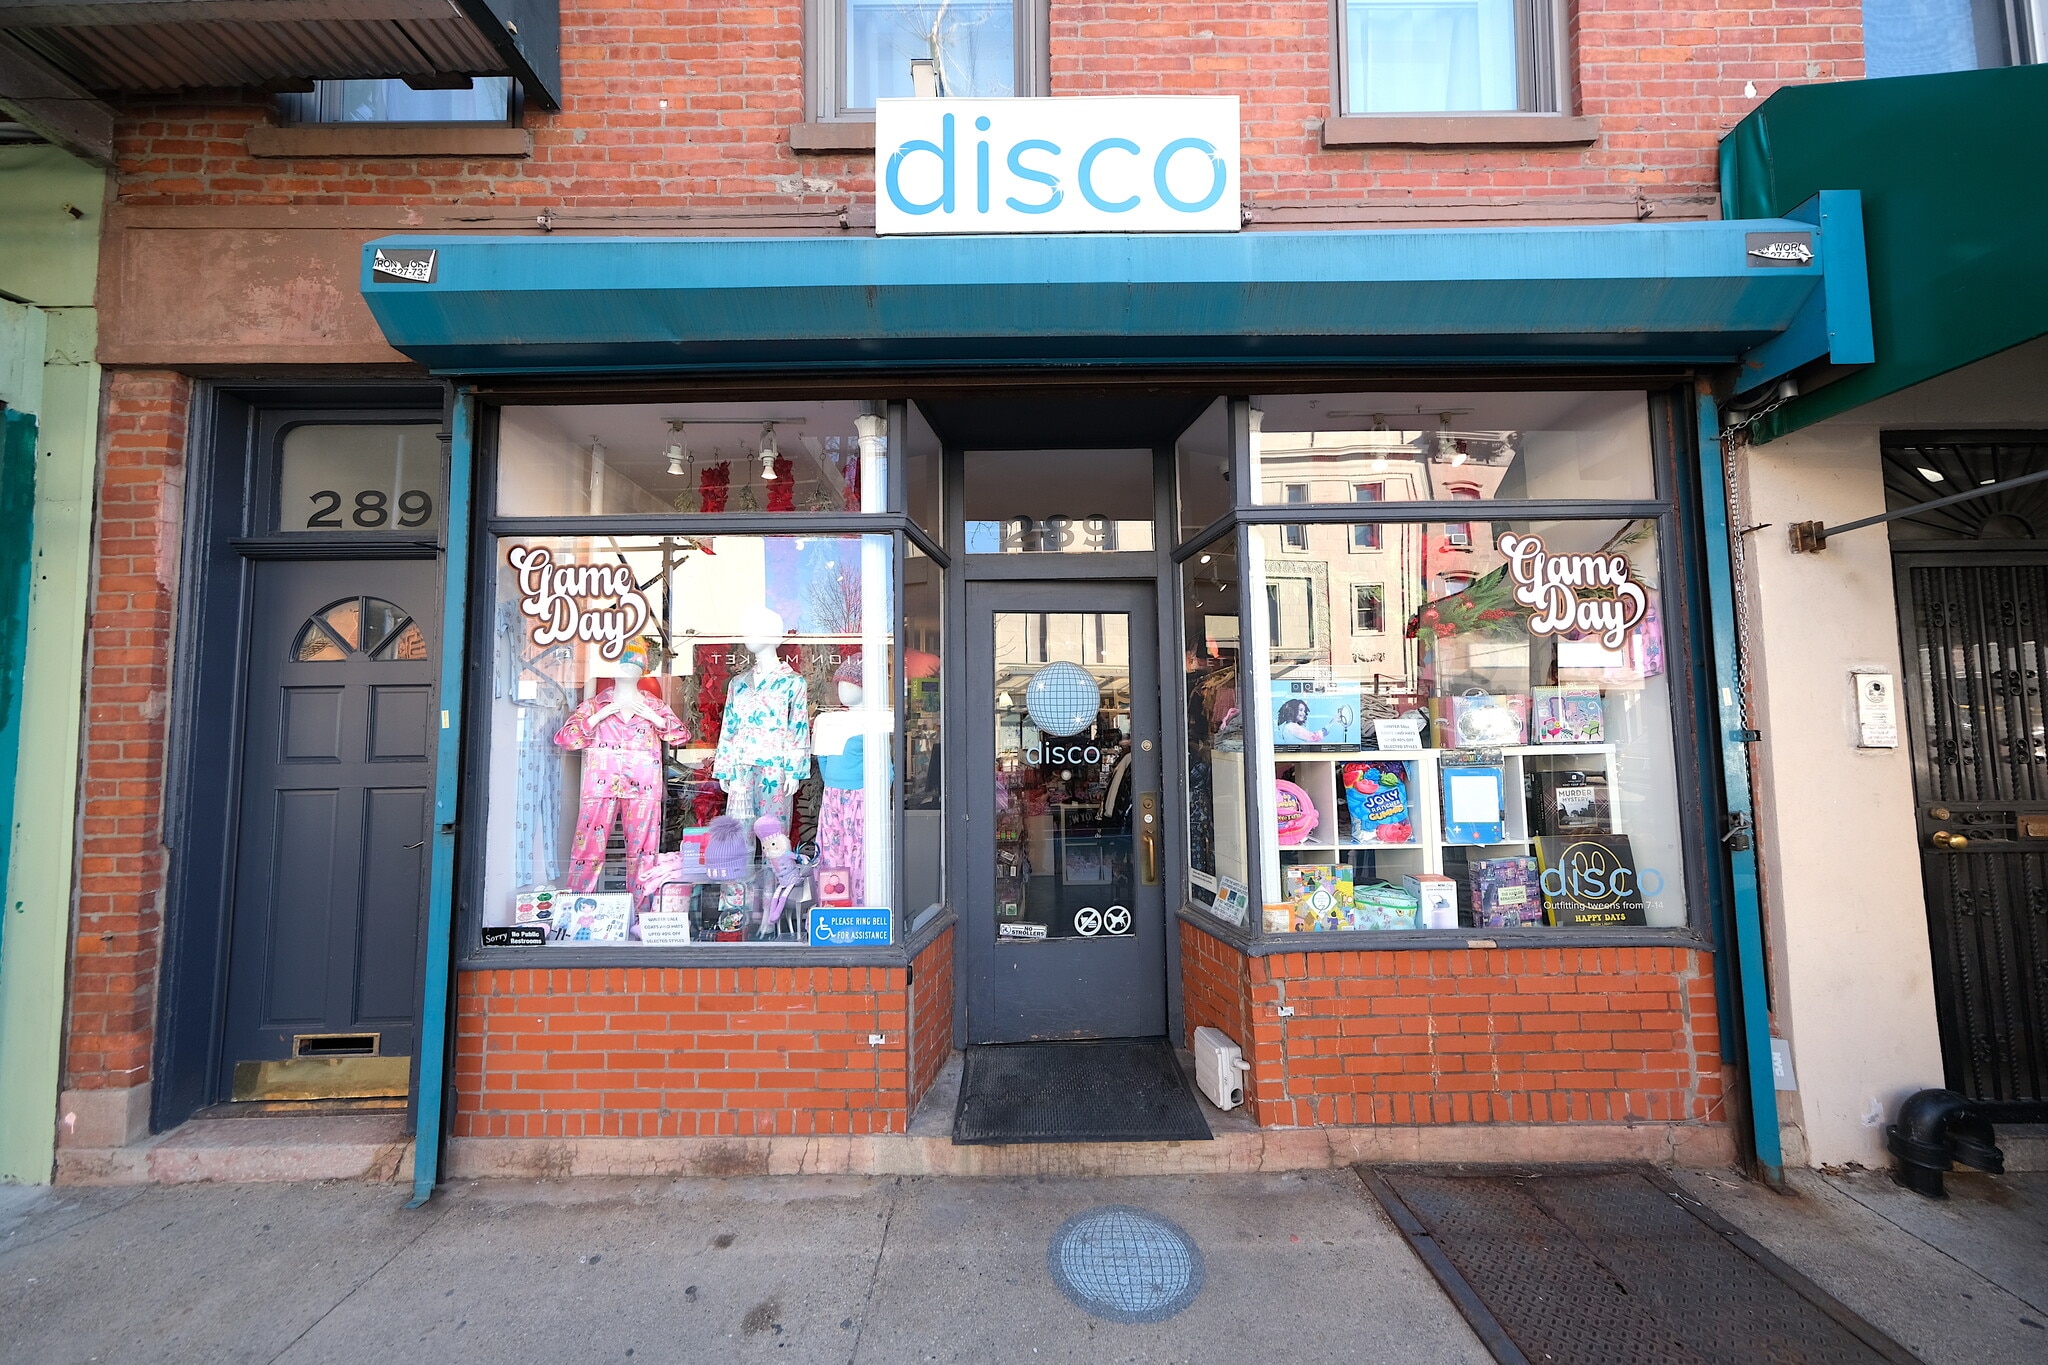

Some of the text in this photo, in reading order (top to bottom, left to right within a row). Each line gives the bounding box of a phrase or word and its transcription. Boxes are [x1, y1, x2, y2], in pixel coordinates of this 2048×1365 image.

[885, 112, 1227, 216] disco
[306, 489, 433, 529] 289
[1004, 513, 1112, 549] 289
[509, 546, 633, 621] Game
[1500, 534, 1628, 610] Game
[533, 592, 648, 659] Day
[1530, 581, 1647, 649] Day
[1026, 742, 1100, 765] disco
[1366, 790, 1398, 808] JOLLY
[1372, 800, 1400, 812] RANCHER
[1540, 858, 1664, 897] disco
[831, 917, 887, 925] PLEASE RING BELL
[1544, 901, 1586, 911] Outfitting
[485, 933, 507, 943] Sorry
[837, 932, 887, 940] FOR ASSISTANCE
[1772, 1052, 1784, 1077] NYC
